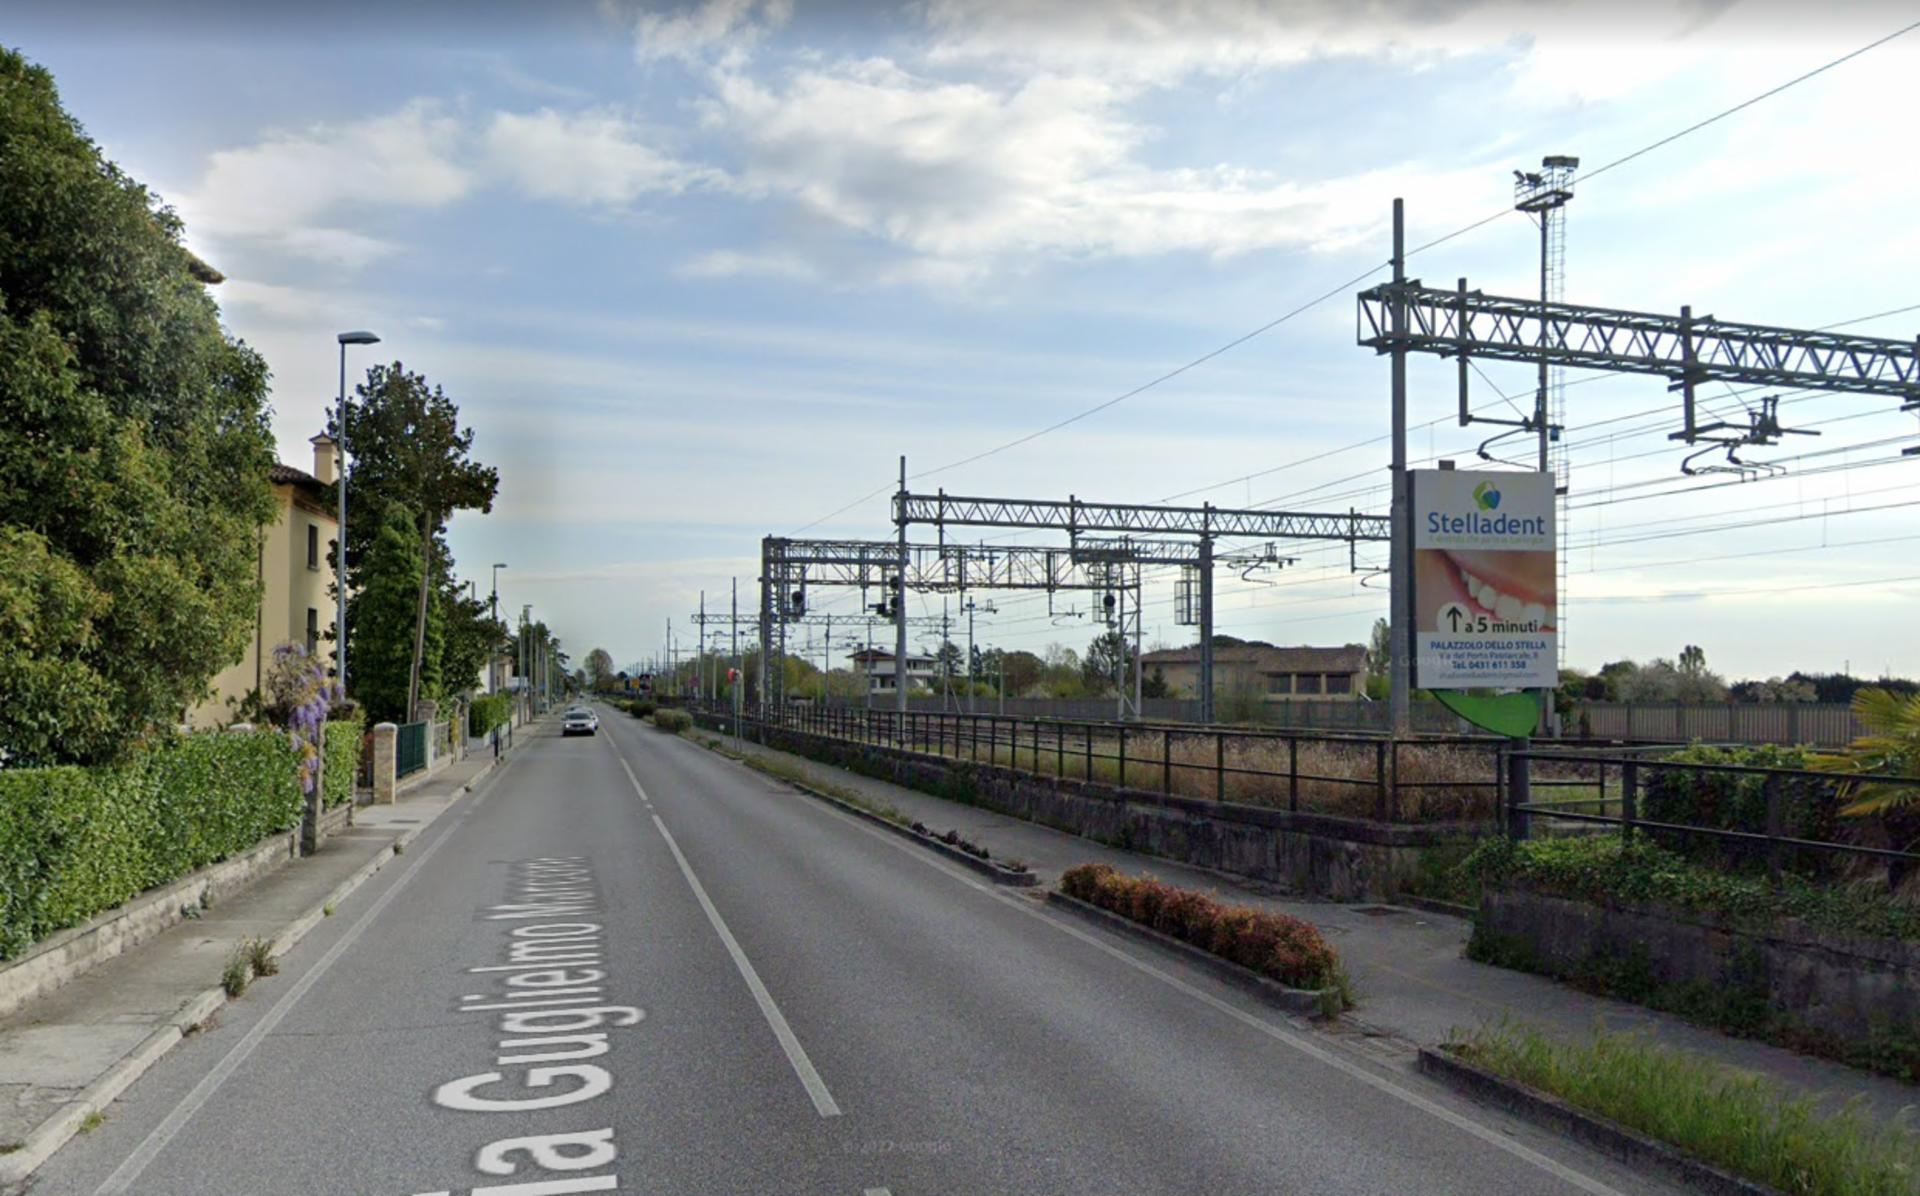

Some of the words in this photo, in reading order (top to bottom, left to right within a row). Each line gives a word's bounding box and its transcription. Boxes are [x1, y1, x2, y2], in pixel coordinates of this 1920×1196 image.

[1428, 512, 1545, 535] Stelladent
[1465, 622, 1473, 633] a
[1477, 617, 1488, 633] 5
[1492, 619, 1538, 633] minuti
[1430, 640, 1484, 650] PALAZZOLO
[1485, 640, 1514, 650] DELLO
[1516, 640, 1546, 650] STELLA
[1452, 660, 1467, 669] Tel.
[1469, 660, 1489, 669] 0431
[1492, 660, 1507, 669] 611
